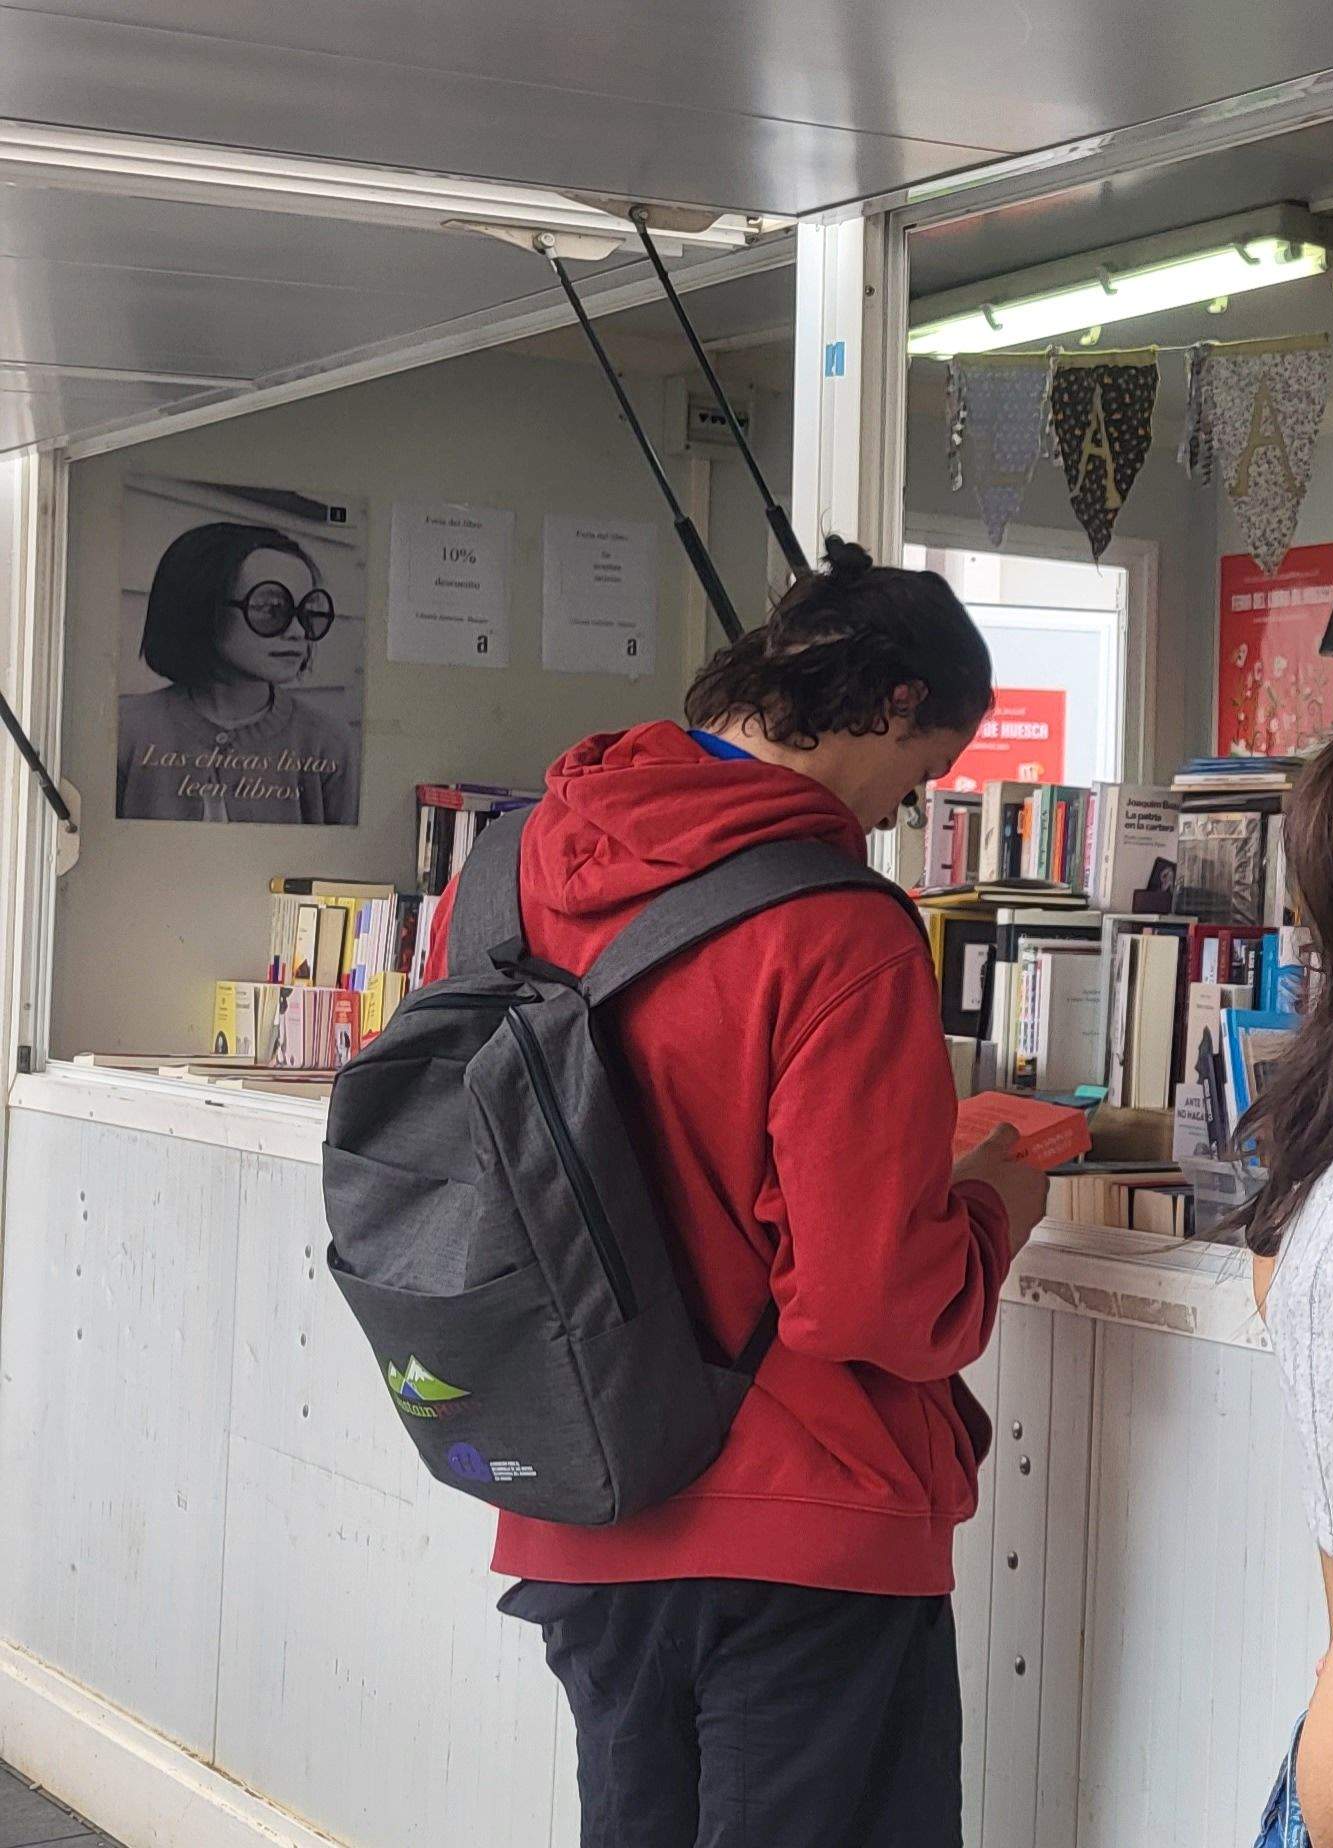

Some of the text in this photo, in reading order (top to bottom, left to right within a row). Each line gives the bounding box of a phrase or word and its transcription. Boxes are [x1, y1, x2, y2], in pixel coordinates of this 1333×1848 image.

[441, 546, 478, 564] 10%
[434, 577, 480, 590] descuento
[476, 634, 488, 654] a
[627, 638, 637, 656] a
[1001, 721, 1049, 740] HUESCA
[142, 744, 337, 772] Las chicas listas
[177, 775, 304, 799] leen libros
